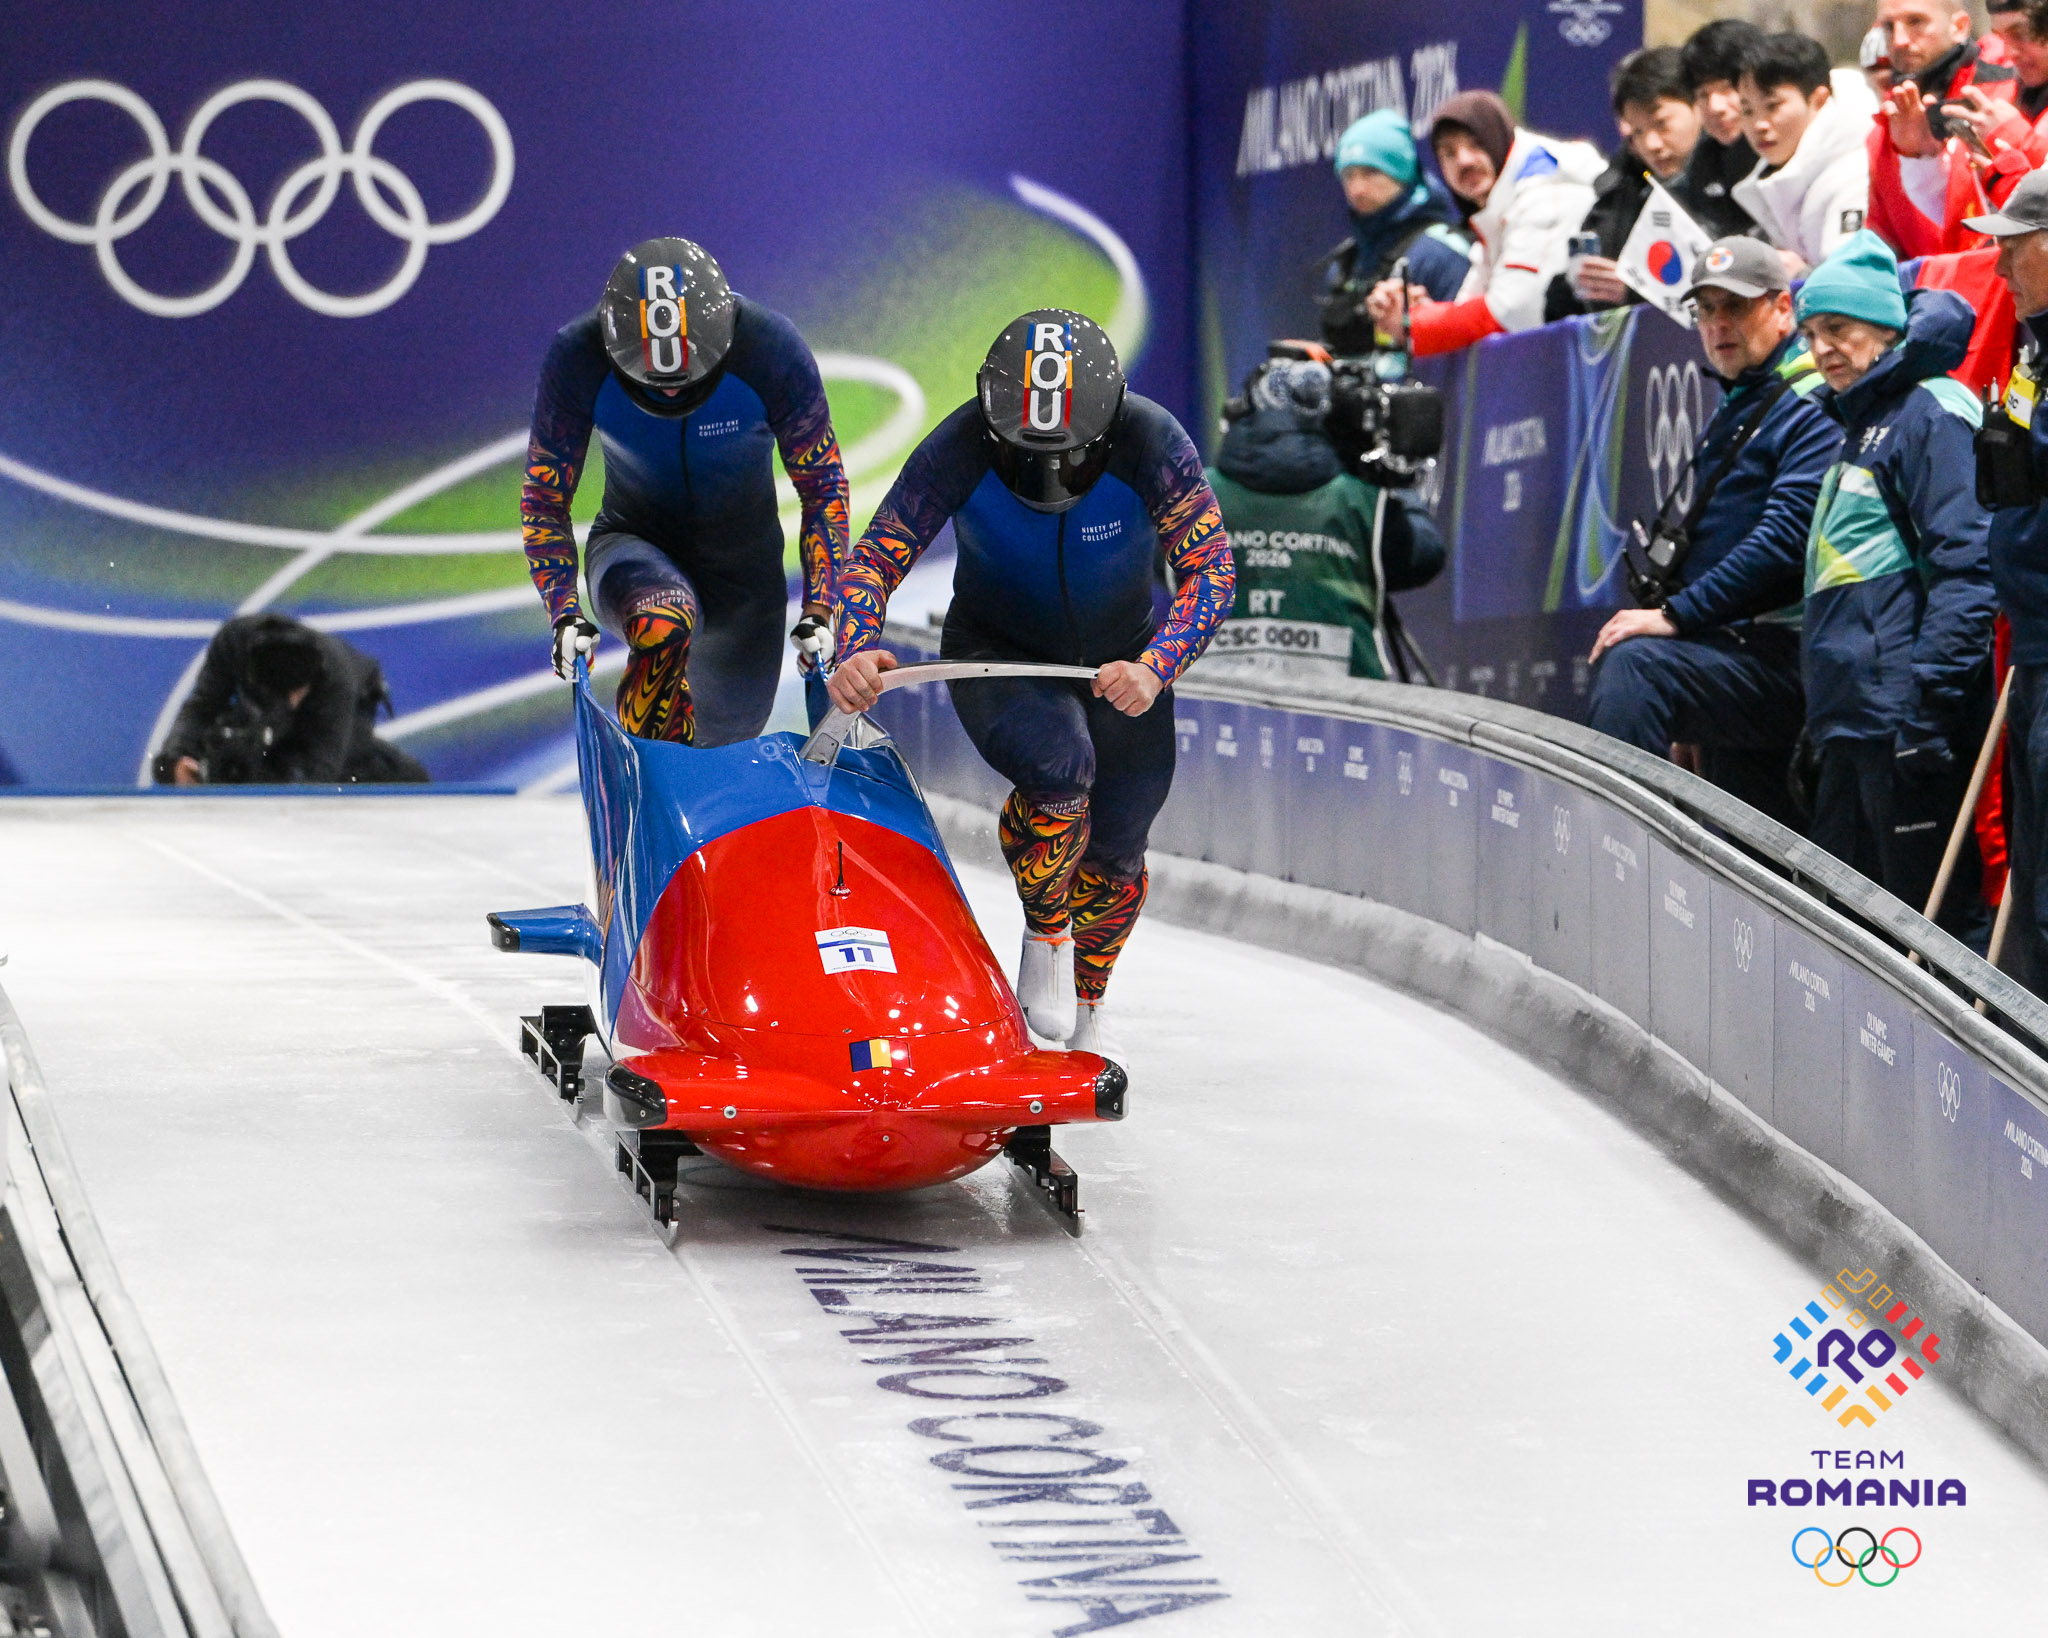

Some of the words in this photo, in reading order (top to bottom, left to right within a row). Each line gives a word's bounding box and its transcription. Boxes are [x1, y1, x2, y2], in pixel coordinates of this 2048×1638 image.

[647, 265, 683, 373] ROU
[1029, 323, 1068, 431] ROU
[1081, 525, 1106, 533] NINETY
[1109, 519, 1121, 530] ONE
[1082, 527, 1122, 542] COLLECTIVE
[1248, 589, 1286, 615] RT
[1265, 625, 1320, 649] 0001
[838, 946, 875, 963] 11
[762, 1224, 1069, 1401] MILANO
[907, 1411, 1232, 1638] CORTINA
